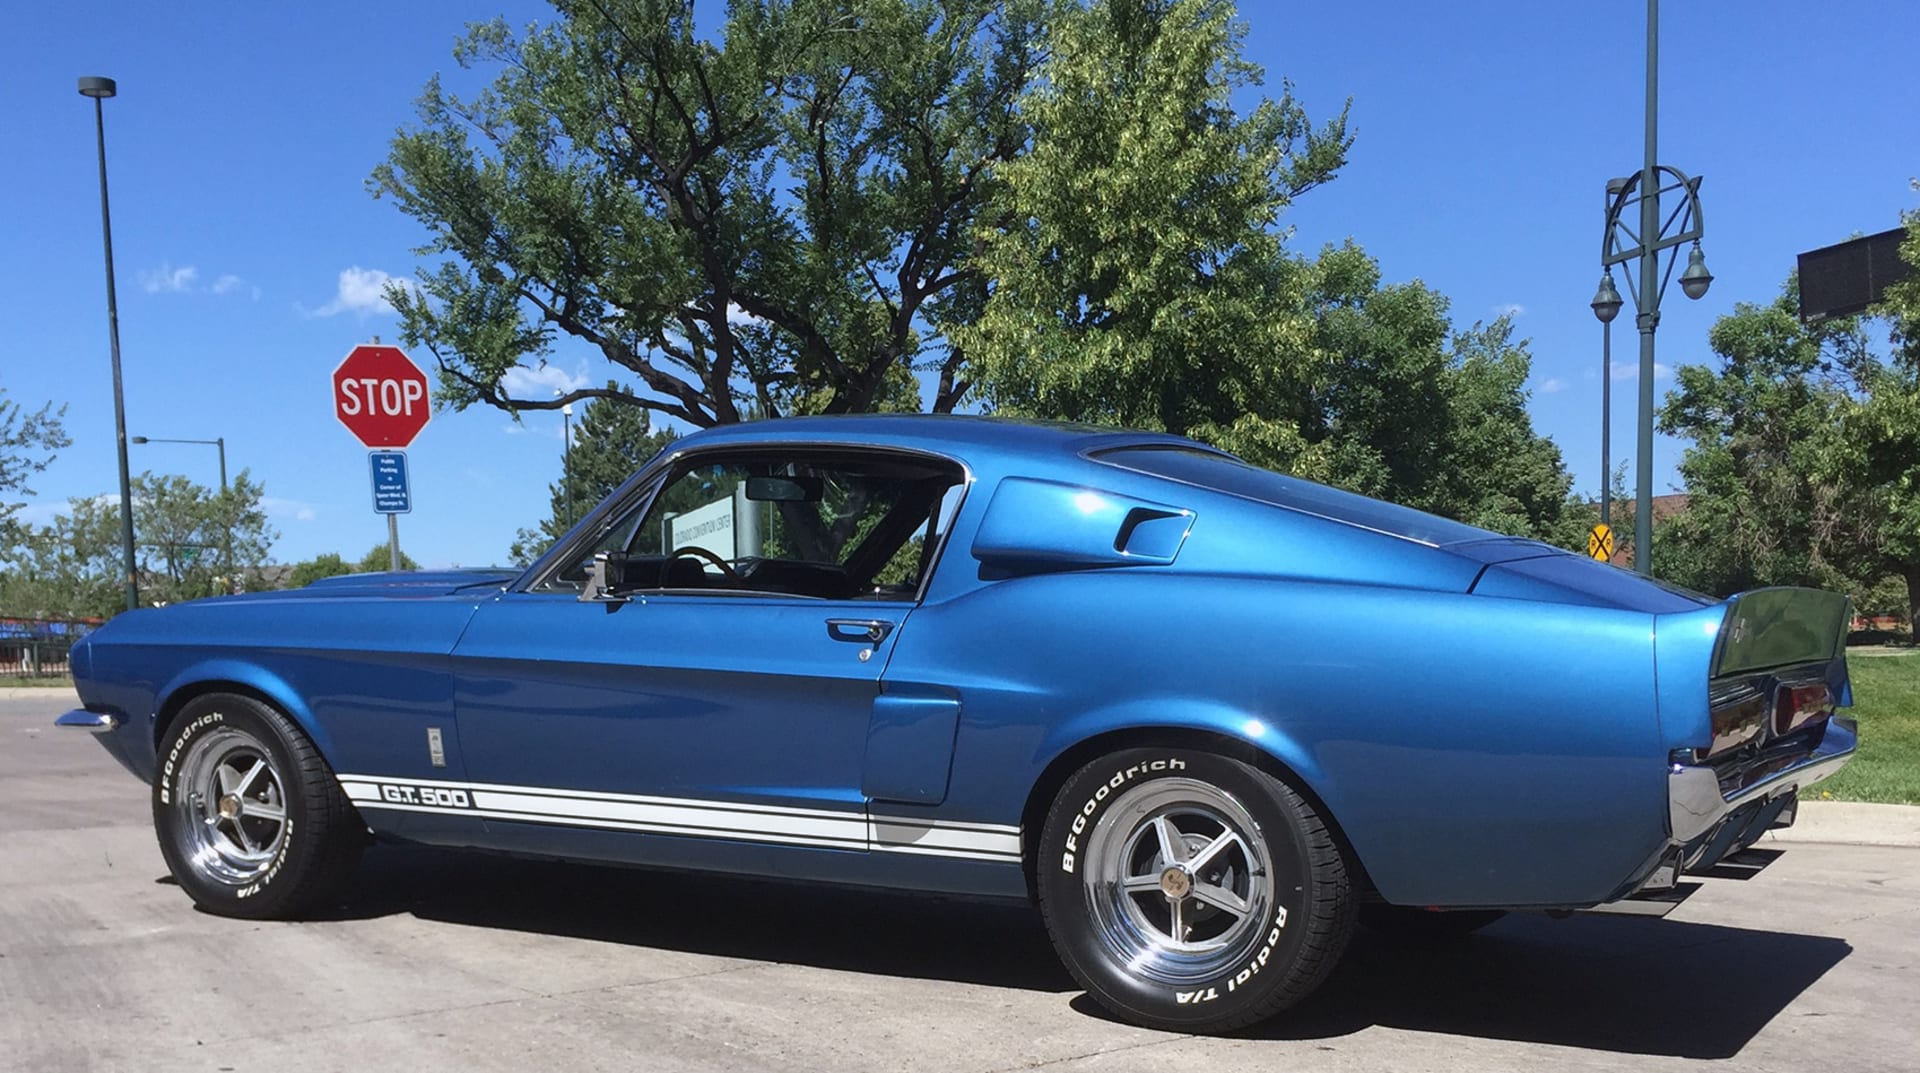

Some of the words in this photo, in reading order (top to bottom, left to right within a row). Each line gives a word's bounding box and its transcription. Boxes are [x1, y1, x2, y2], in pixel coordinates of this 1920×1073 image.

[341, 377, 423, 416] STOP
[161, 711, 223, 804] BFGoodrich
[1062, 758, 1186, 873] BFGoodrich
[237, 883, 260, 898] T/A
[1228, 905, 1288, 992] Radial
[1175, 987, 1219, 1004] T/A
